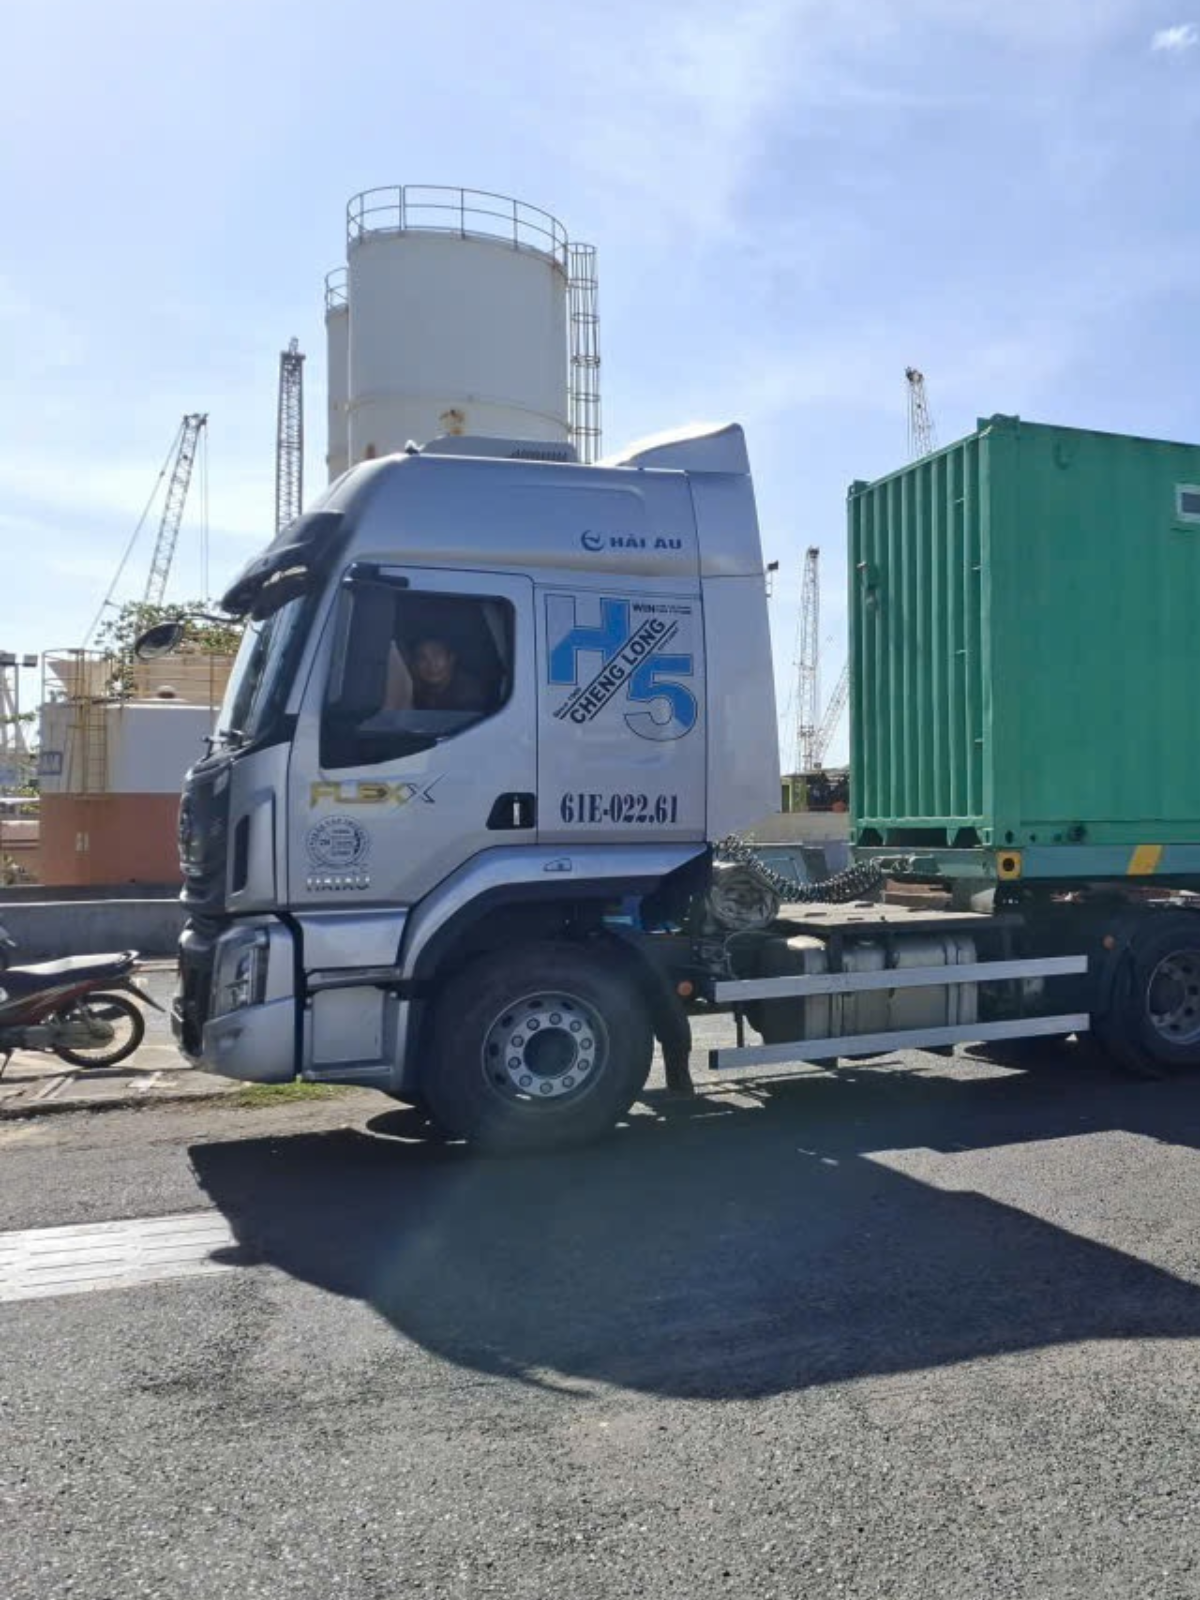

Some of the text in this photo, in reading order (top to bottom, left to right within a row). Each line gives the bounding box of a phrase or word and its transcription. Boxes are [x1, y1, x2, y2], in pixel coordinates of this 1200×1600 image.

[570, 617, 666, 724] CHENG LONG
[560, 793, 679, 825] 61E-022.61
